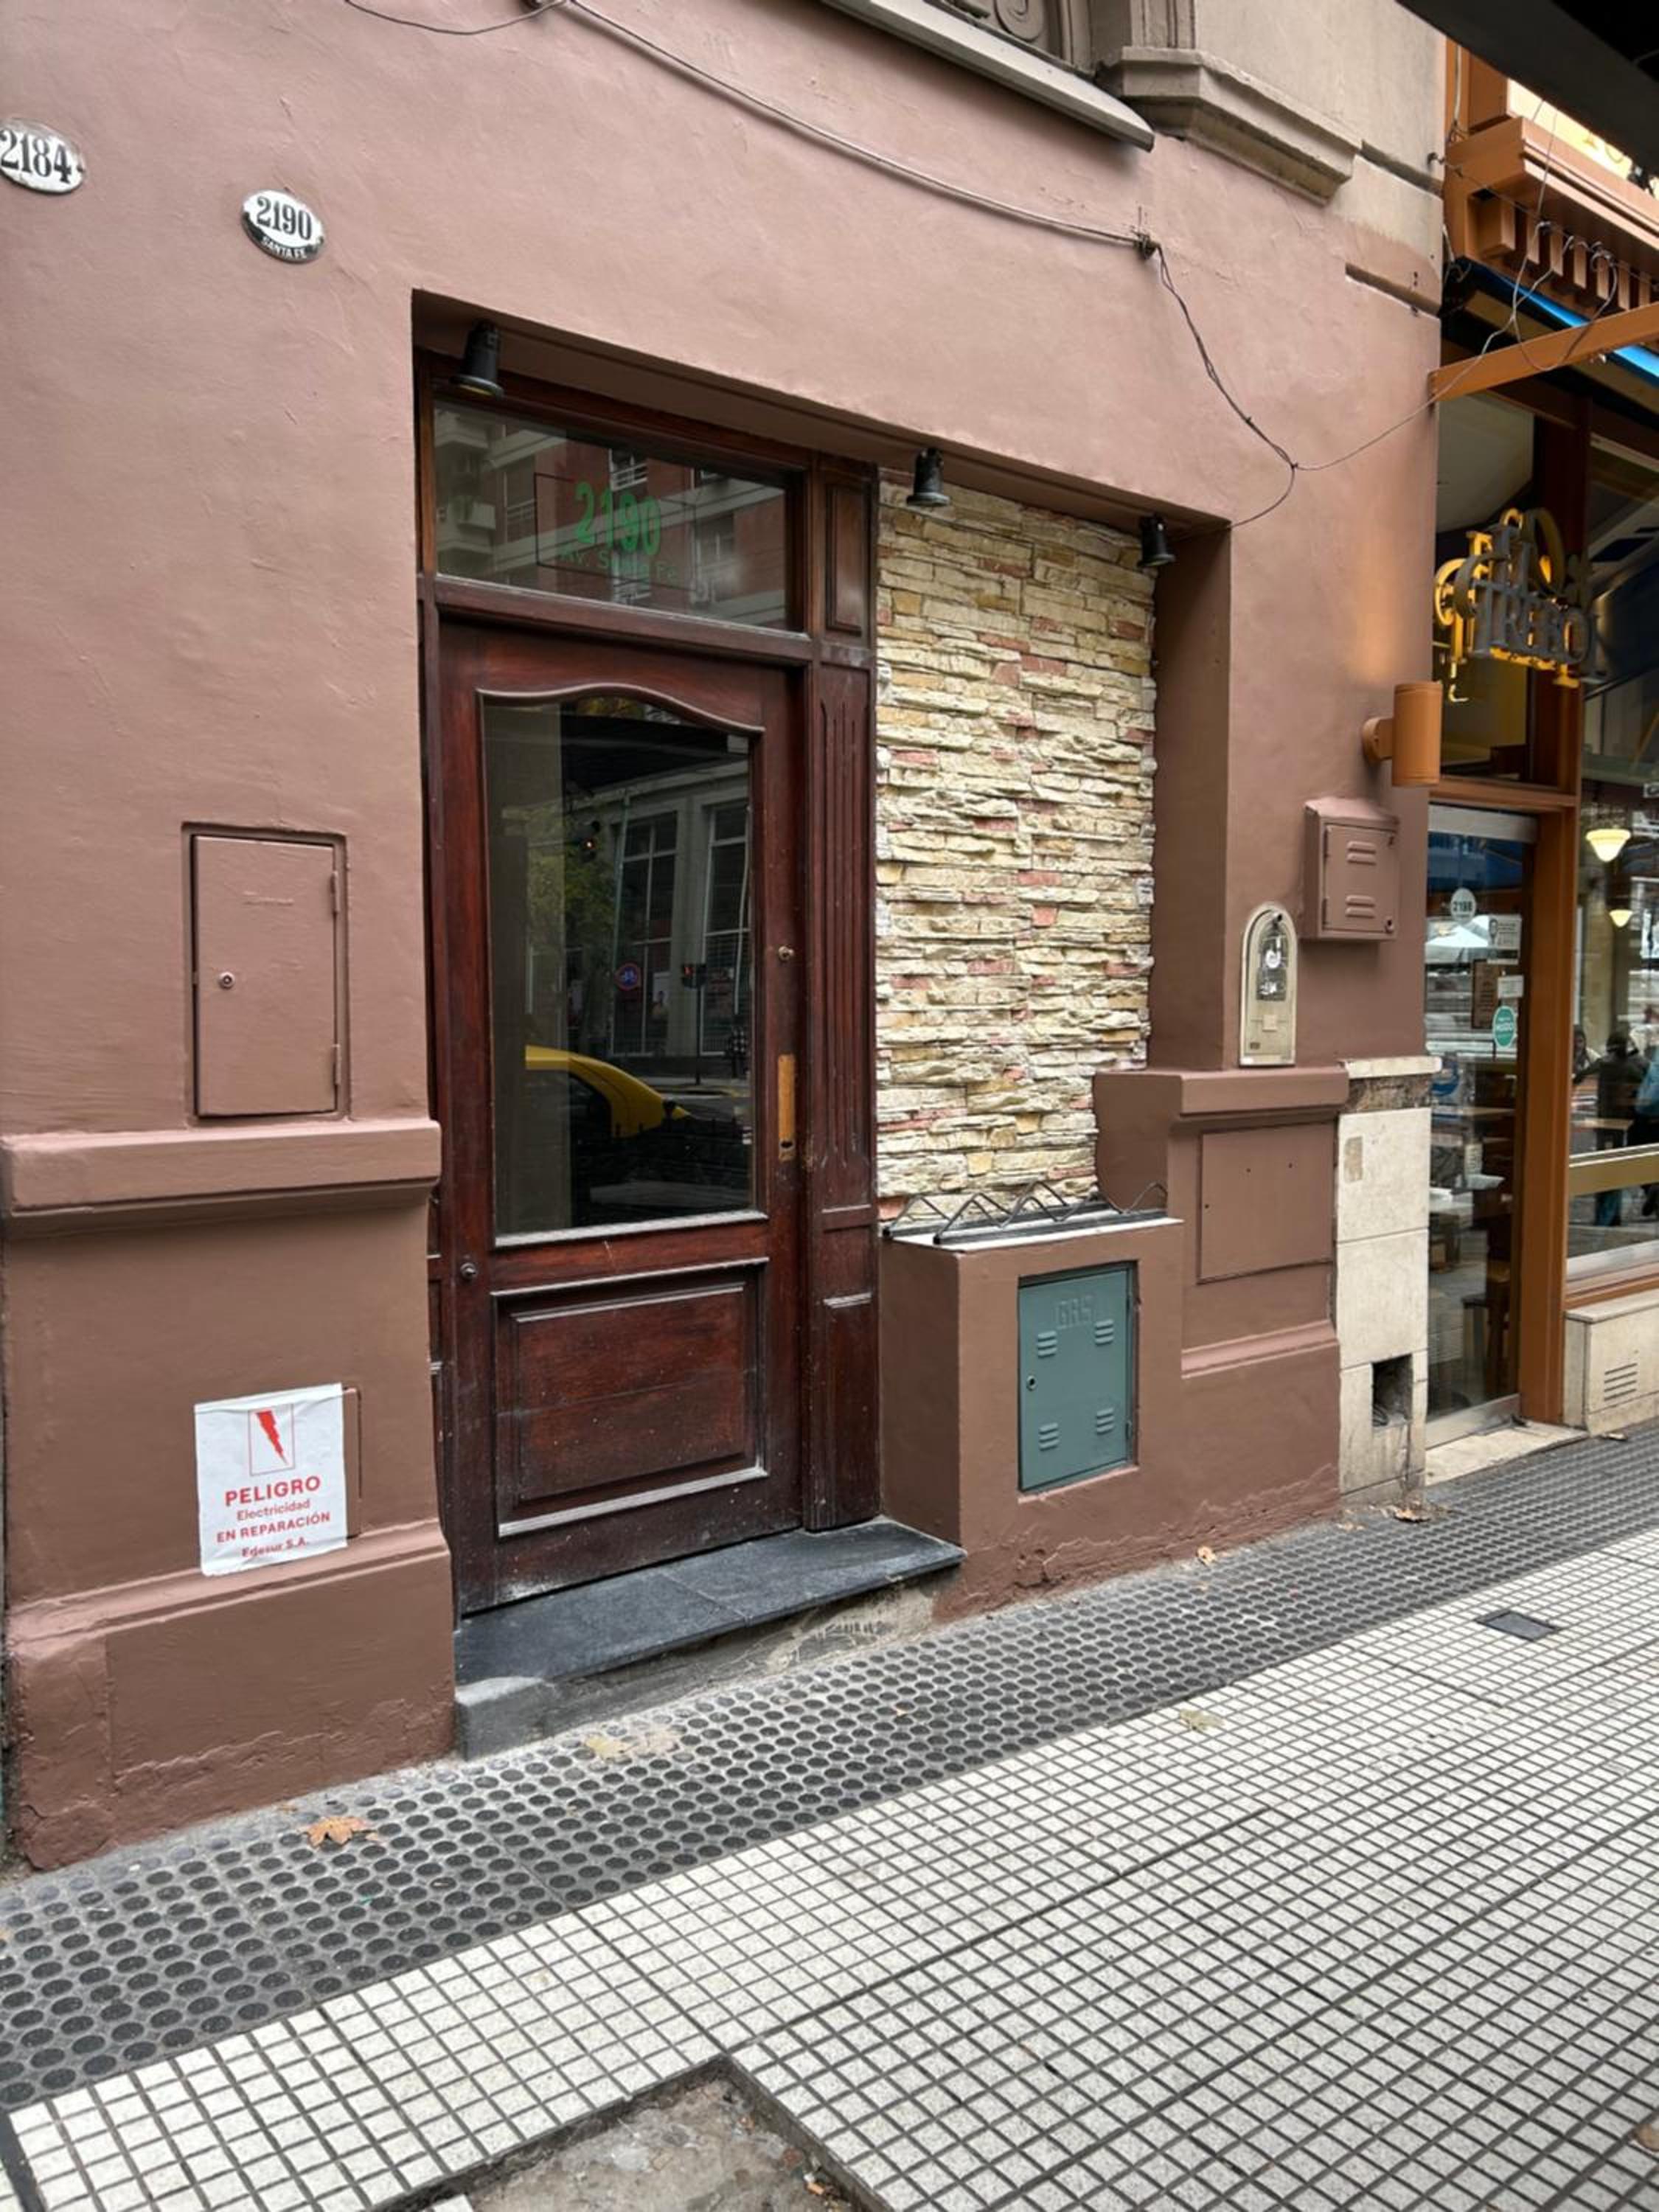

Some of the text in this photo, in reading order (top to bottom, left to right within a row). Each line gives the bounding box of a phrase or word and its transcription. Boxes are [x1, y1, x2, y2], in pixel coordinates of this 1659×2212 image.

[0, 128, 72, 184] 2184
[257, 195, 312, 240] 2190
[261, 235, 293, 258] SANTA
[574, 481, 661, 555] 2190
[1055, 1295, 1096, 1330] GAS
[225, 1475, 321, 1507] PELIGRO
[237, 1498, 310, 1521] Electricidad
[216, 1512, 330, 1543] EN REPARACIÓN
